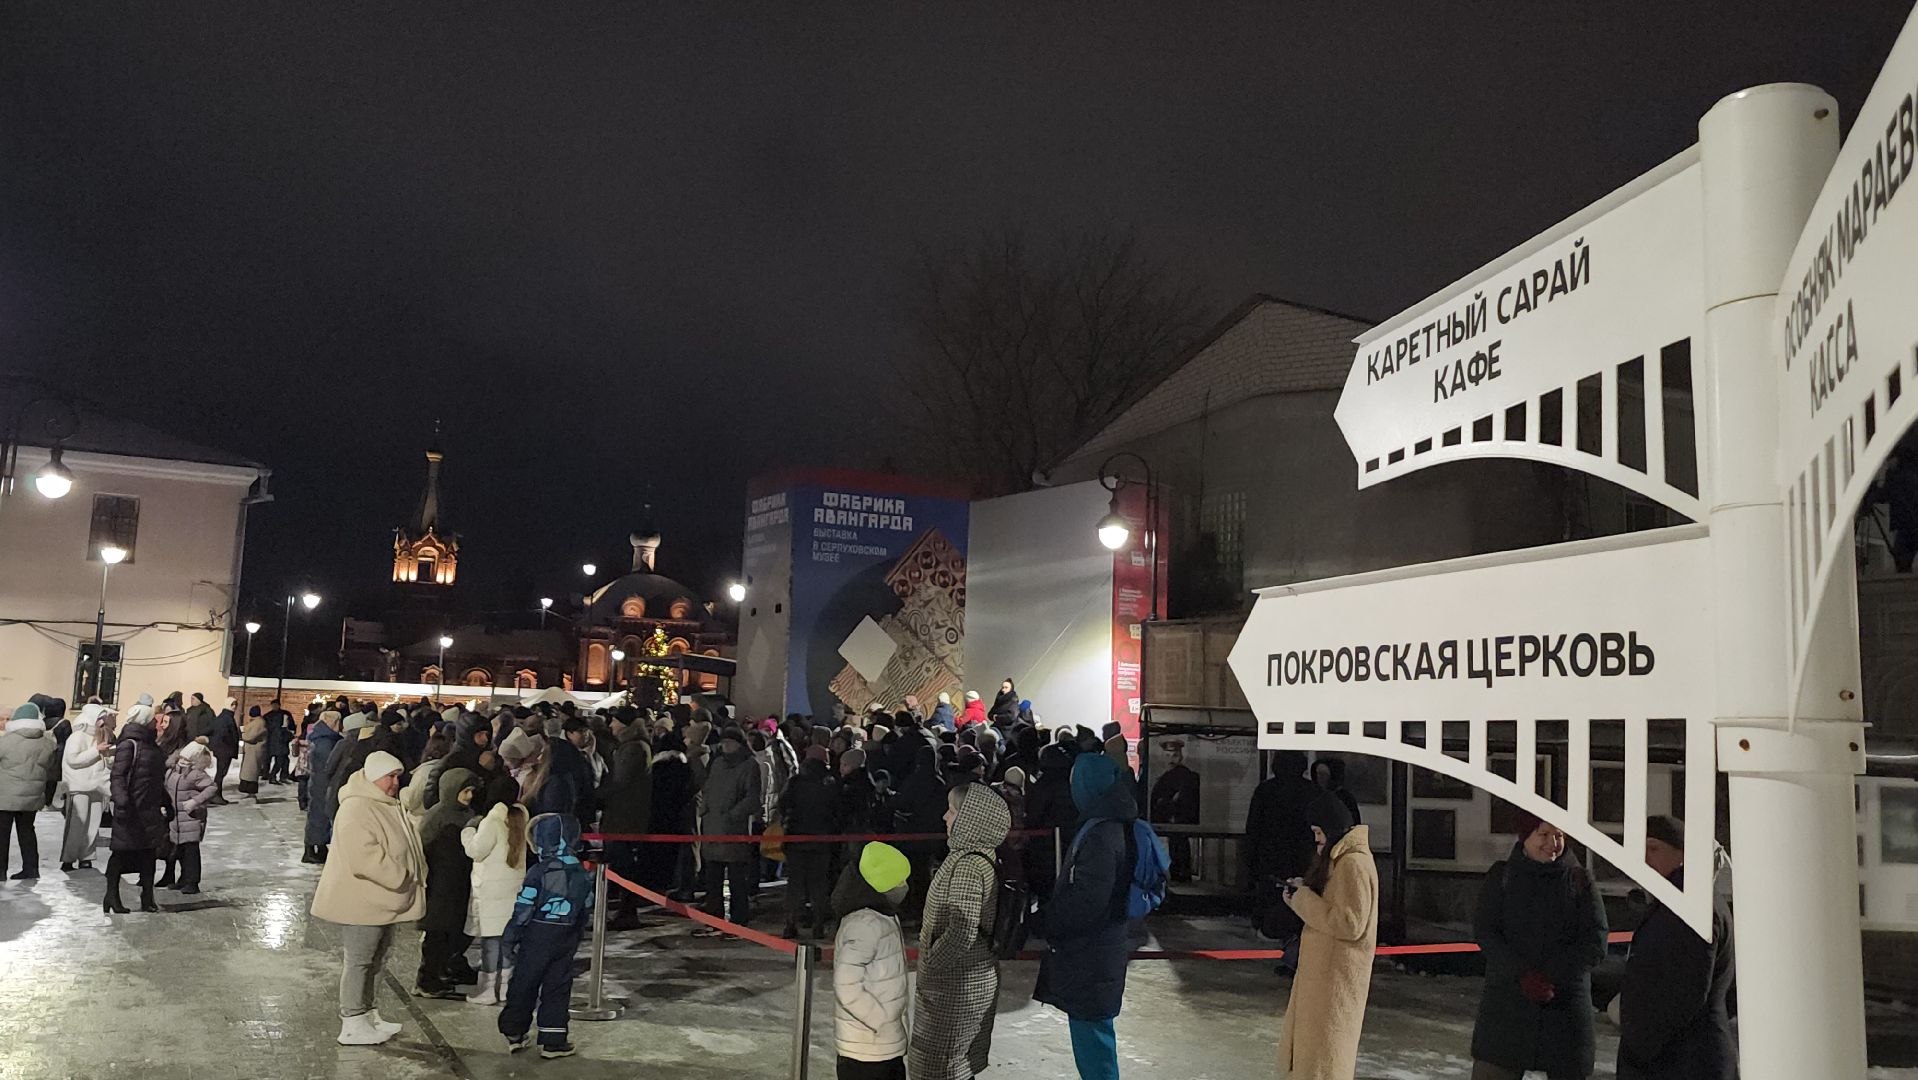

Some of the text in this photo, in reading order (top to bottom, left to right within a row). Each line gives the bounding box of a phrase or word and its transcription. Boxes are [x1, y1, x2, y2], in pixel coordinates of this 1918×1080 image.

[1785, 80, 1918, 373] ОСОБНЯК МАРАЕВ
[1367, 236, 1590, 386] КАРЕТНЫЙ САРАЙ
[1434, 339, 1502, 404] КАФЕ
[1810, 298, 1858, 419] КАССА
[814, 507, 913, 531] АВАНГАРДА
[823, 492, 905, 515] ФАБРИКА
[813, 527, 858, 541] ВЫСТАВКА
[821, 542, 887, 557] СЕРПУХОВСКОМ
[812, 551, 840, 563] МУЗЕЕ
[1267, 630, 1655, 689] ПОКРОВСКАЯ ЦЕРКОВЬ
